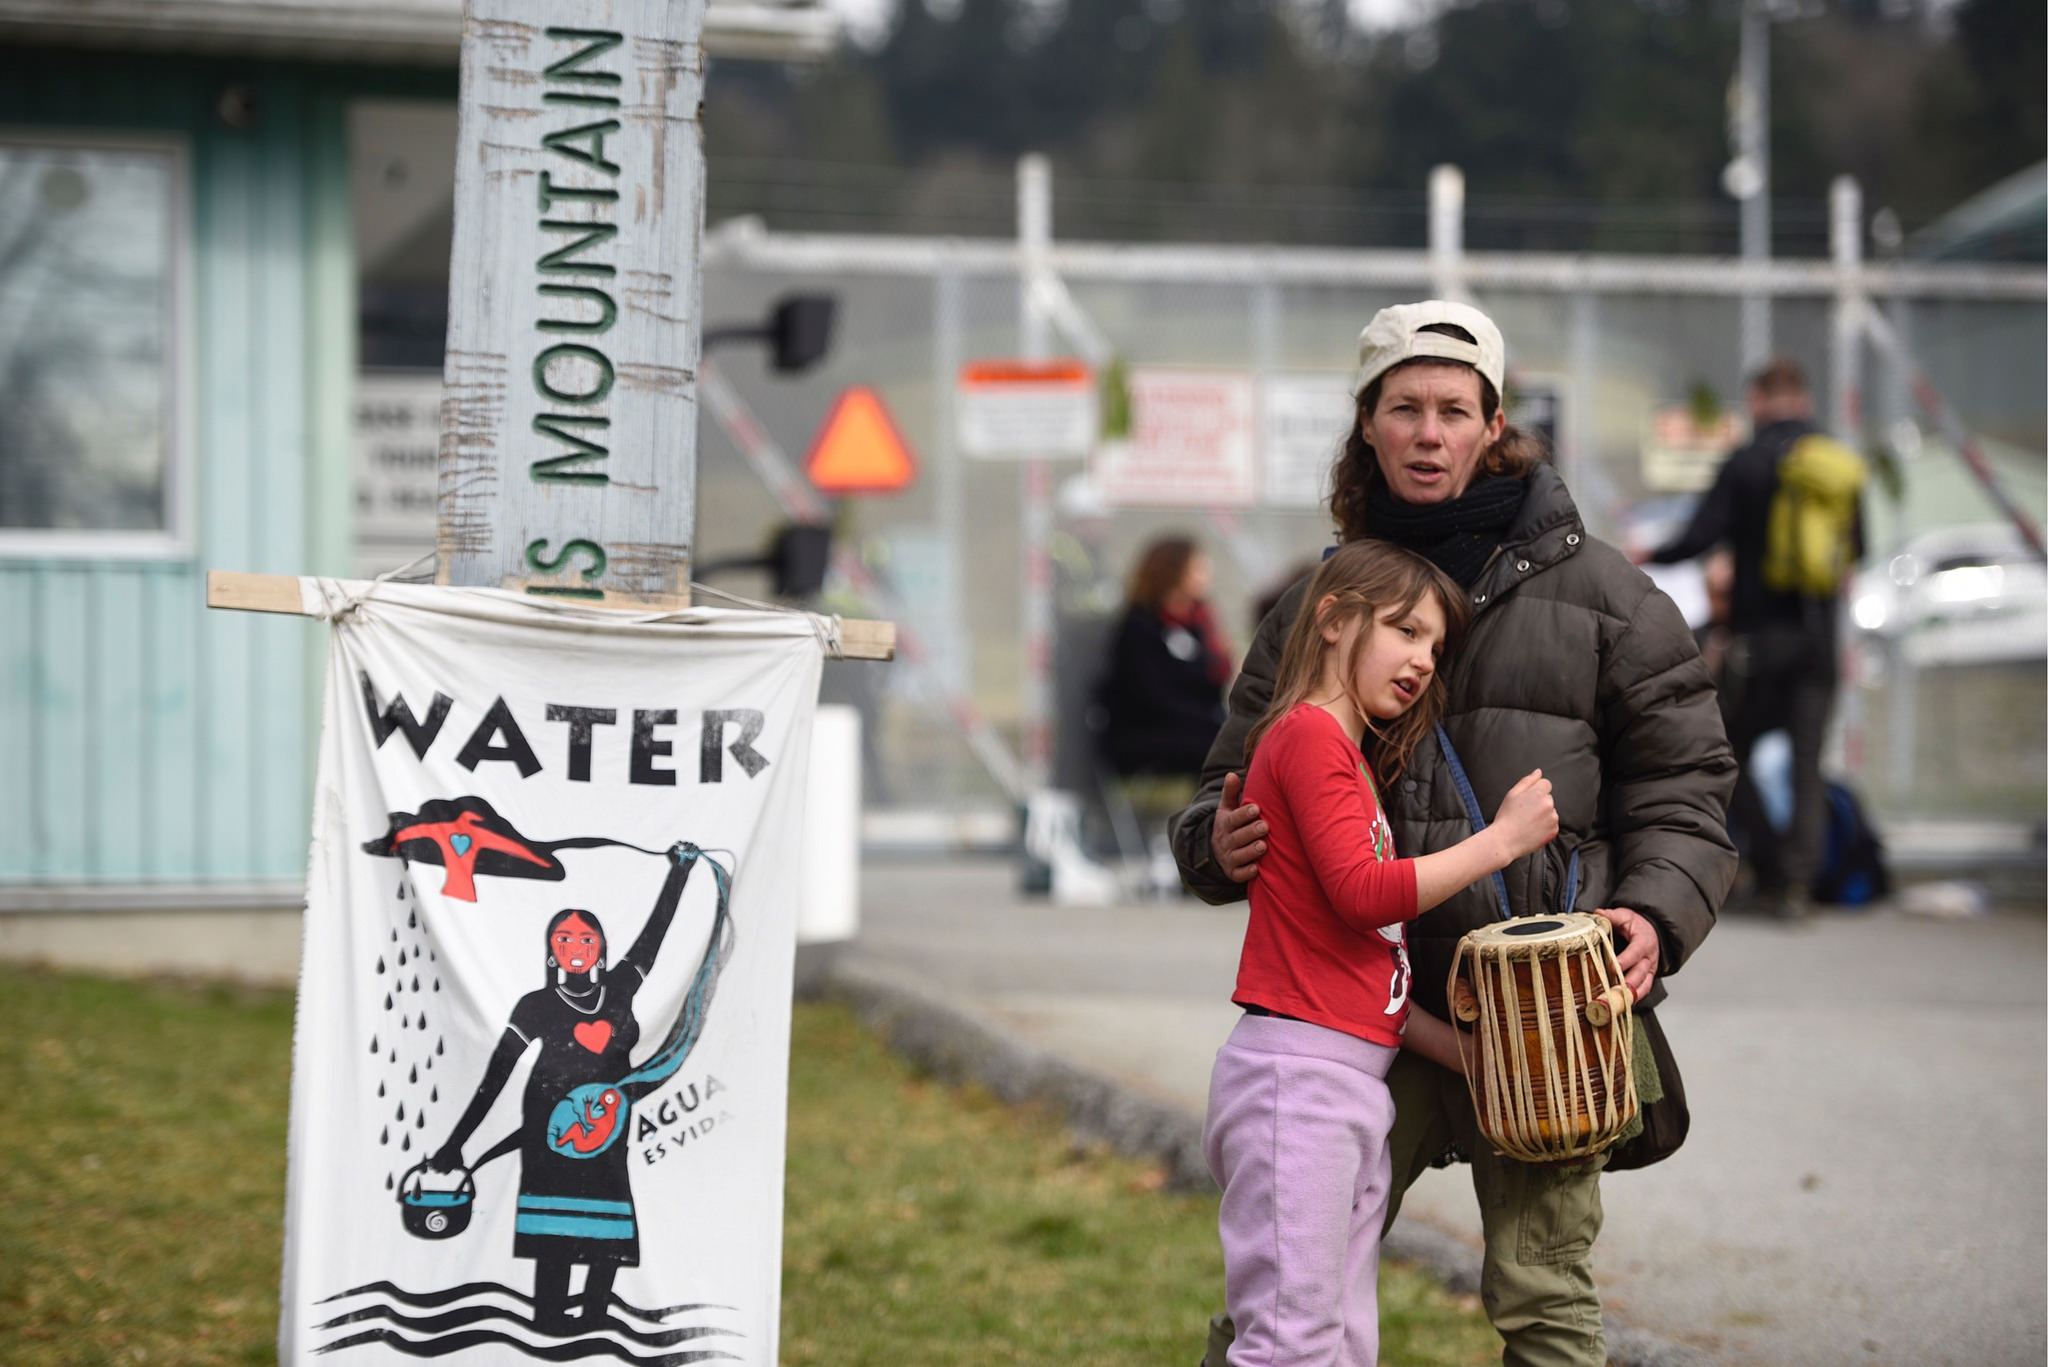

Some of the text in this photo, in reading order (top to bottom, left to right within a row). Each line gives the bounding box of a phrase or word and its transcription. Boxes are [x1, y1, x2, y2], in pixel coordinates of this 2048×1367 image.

[523, 26, 624, 601] IS MOUNTAIN
[359, 668, 771, 787] WATER
[637, 1074, 727, 1142] AGUA
[643, 1110, 735, 1166] ES VIDA
